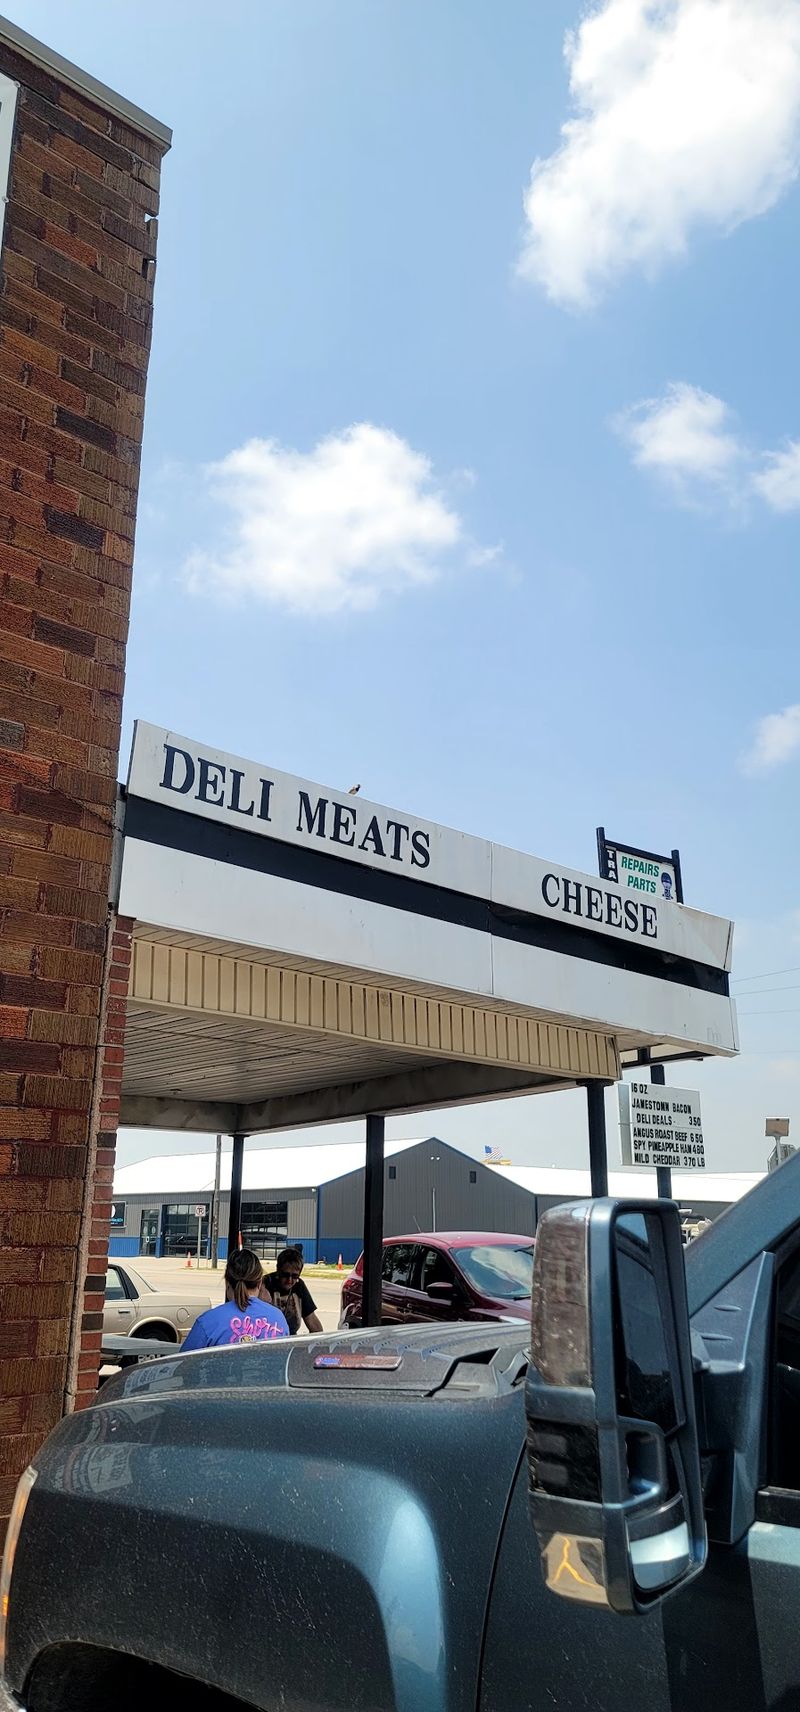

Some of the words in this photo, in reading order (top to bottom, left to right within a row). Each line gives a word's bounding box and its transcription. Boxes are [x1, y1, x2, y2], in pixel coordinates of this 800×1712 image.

[159, 743, 275, 822] DELI
[296, 790, 431, 869] MEATS
[621, 855, 660, 877] REPAIRS
[627, 875, 656, 893] PARTS
[541, 873, 658, 939] CHEESE
[631, 1082, 638, 1093] 16
[639, 1083, 648, 1094] OZ
[632, 1098, 669, 1111] JAMESTOWN
[672, 1102, 692, 1114] BACON
[636, 1113, 651, 1124] DELI
[652, 1114, 673, 1126] DEALS
[633, 1127, 655, 1139] ANGUS
[655, 1129, 674, 1140] ROAST
[674, 1131, 688, 1142] BEEF
[647, 1141, 680, 1153] PINEAPPLE
[652, 1154, 681, 1166] CHEDDAR
[697, 1157, 706, 1167] LB
[229, 1315, 285, 1343] Short
